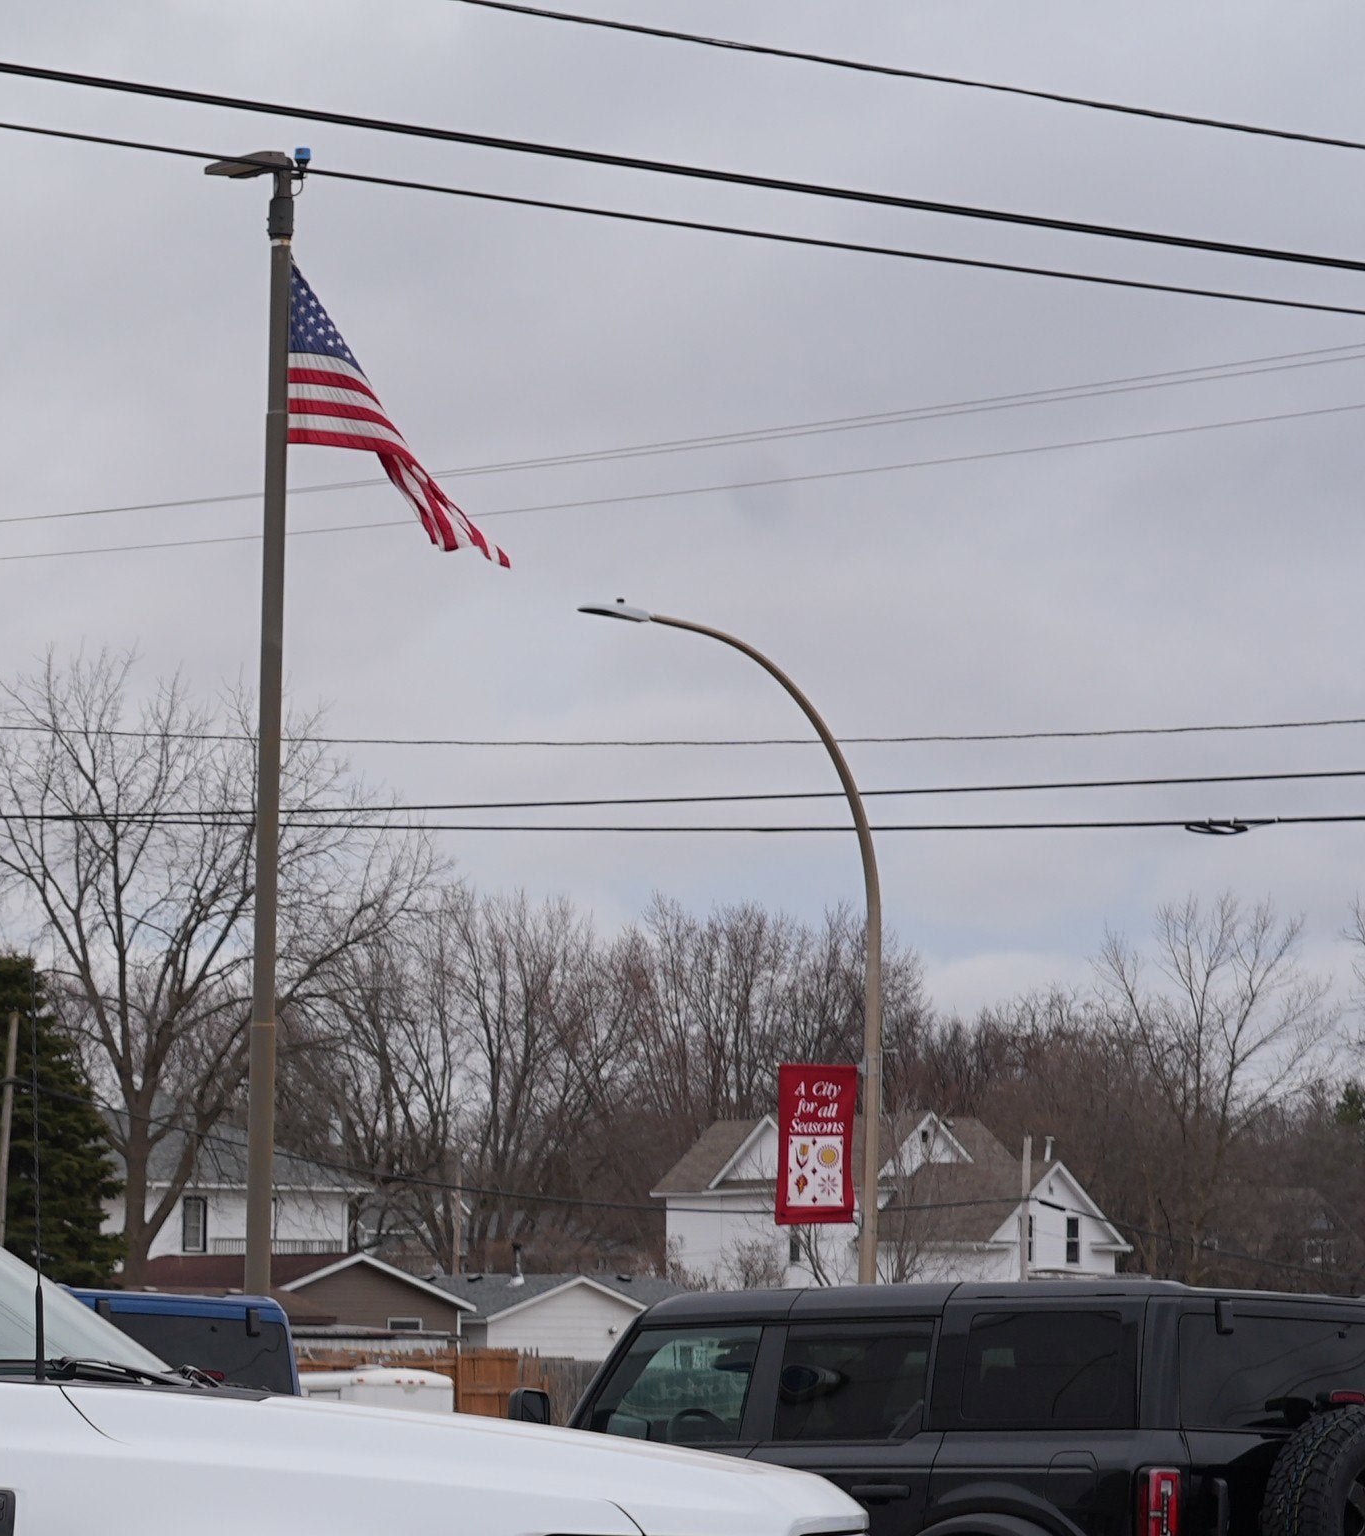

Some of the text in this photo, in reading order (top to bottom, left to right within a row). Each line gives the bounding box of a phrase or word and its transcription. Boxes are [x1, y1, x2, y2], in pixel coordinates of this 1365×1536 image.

[794, 1081, 841, 1101] A City
[794, 1098, 839, 1118] for all
[789, 1118, 845, 1134] Seasons
